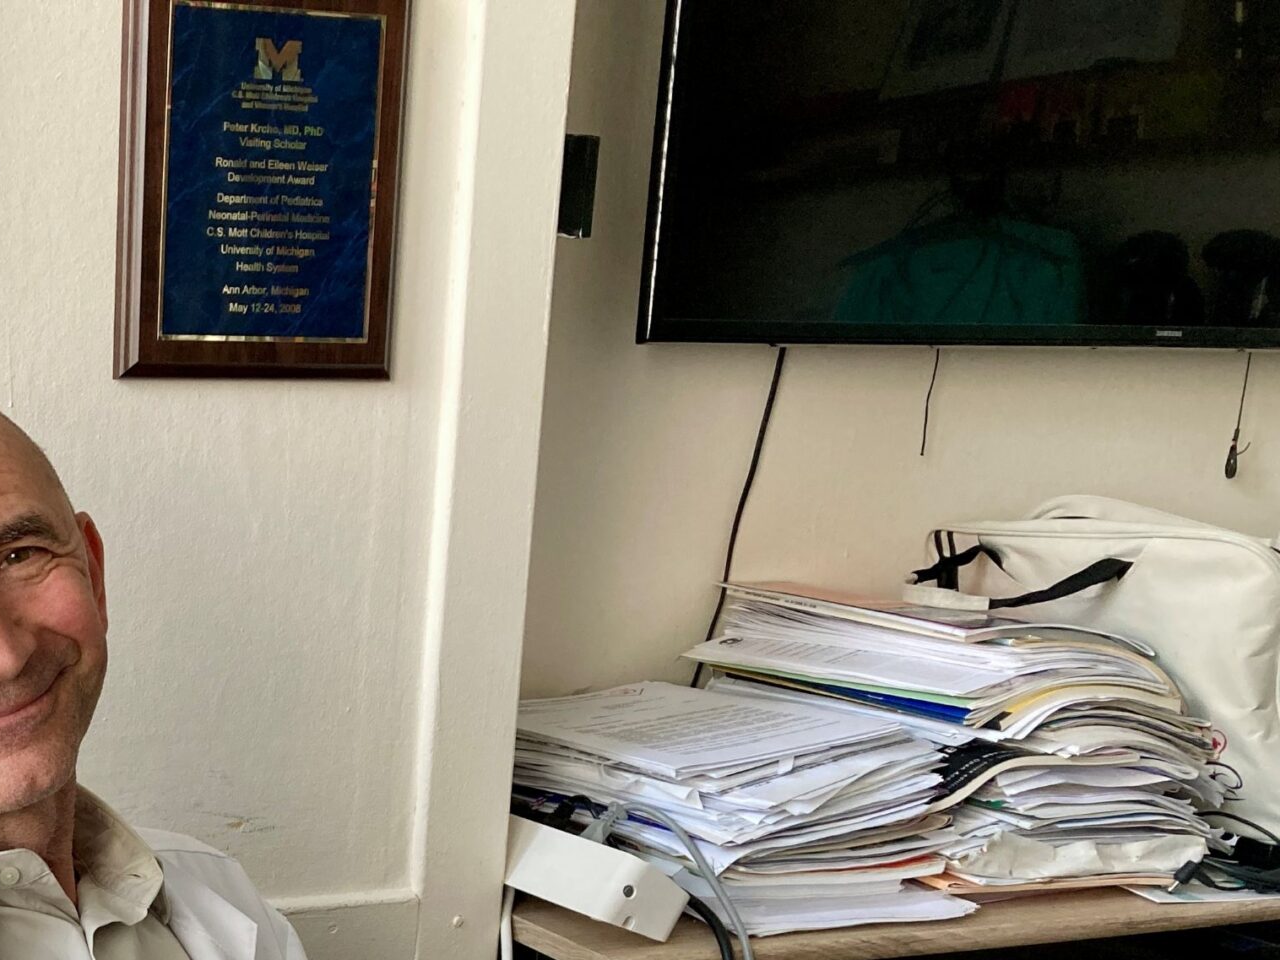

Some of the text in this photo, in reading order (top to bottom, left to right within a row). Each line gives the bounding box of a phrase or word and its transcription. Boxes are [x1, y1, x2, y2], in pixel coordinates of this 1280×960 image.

[254, 37, 303, 82] M
[223, 121, 325, 137] Peter Krcho, MD, PhD
[240, 137, 307, 150] Visiting Scholar
[215, 157, 328, 172] Ronald and Eileen Weiser
[228, 172, 315, 185] Development Award
[217, 192, 324, 206] Department of Pediatrics
[292, 212, 330, 223] Medicine
[207, 227, 330, 241] C.S. Mott Children's Hospital
[221, 244, 315, 258] University of Michigan
[236, 261, 298, 274] Health System
[222, 284, 309, 298] Ann Arbor, Michigan
[229, 302, 248, 314] May
[251, 303, 277, 313] 12-24,
